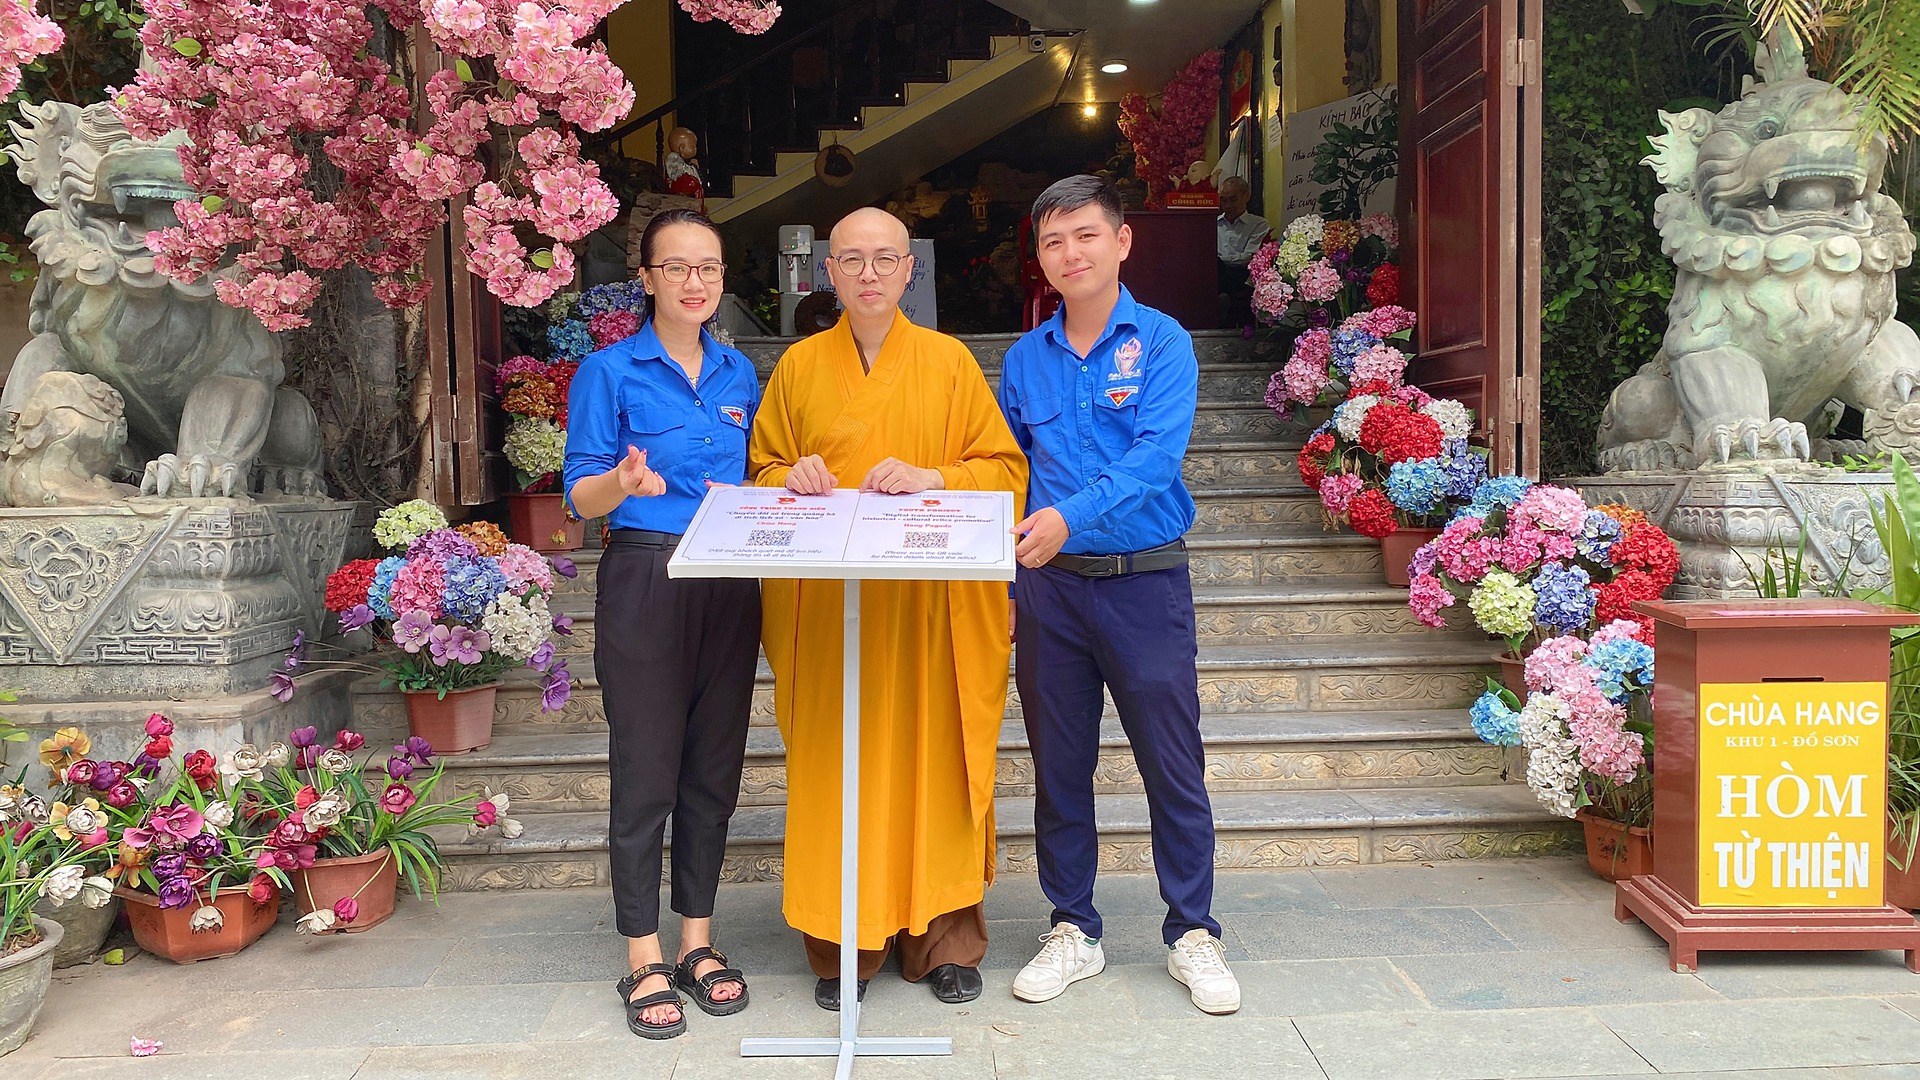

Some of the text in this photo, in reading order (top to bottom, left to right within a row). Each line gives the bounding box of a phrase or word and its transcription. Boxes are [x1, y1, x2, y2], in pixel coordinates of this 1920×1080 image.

[1319, 110, 1347, 130] KÍNH
[1705, 694, 1880, 727] CHÙA HANG
[1725, 736, 1765, 747] KHU
[1770, 736, 1778, 747] 1
[1792, 731, 1818, 748] ĐỒ
[1822, 734, 1860, 747] SƠN
[1716, 760, 1869, 819] HÒM
[1713, 829, 1870, 900] TỪ THIỆN
[632, 965, 651, 980] DIOR
